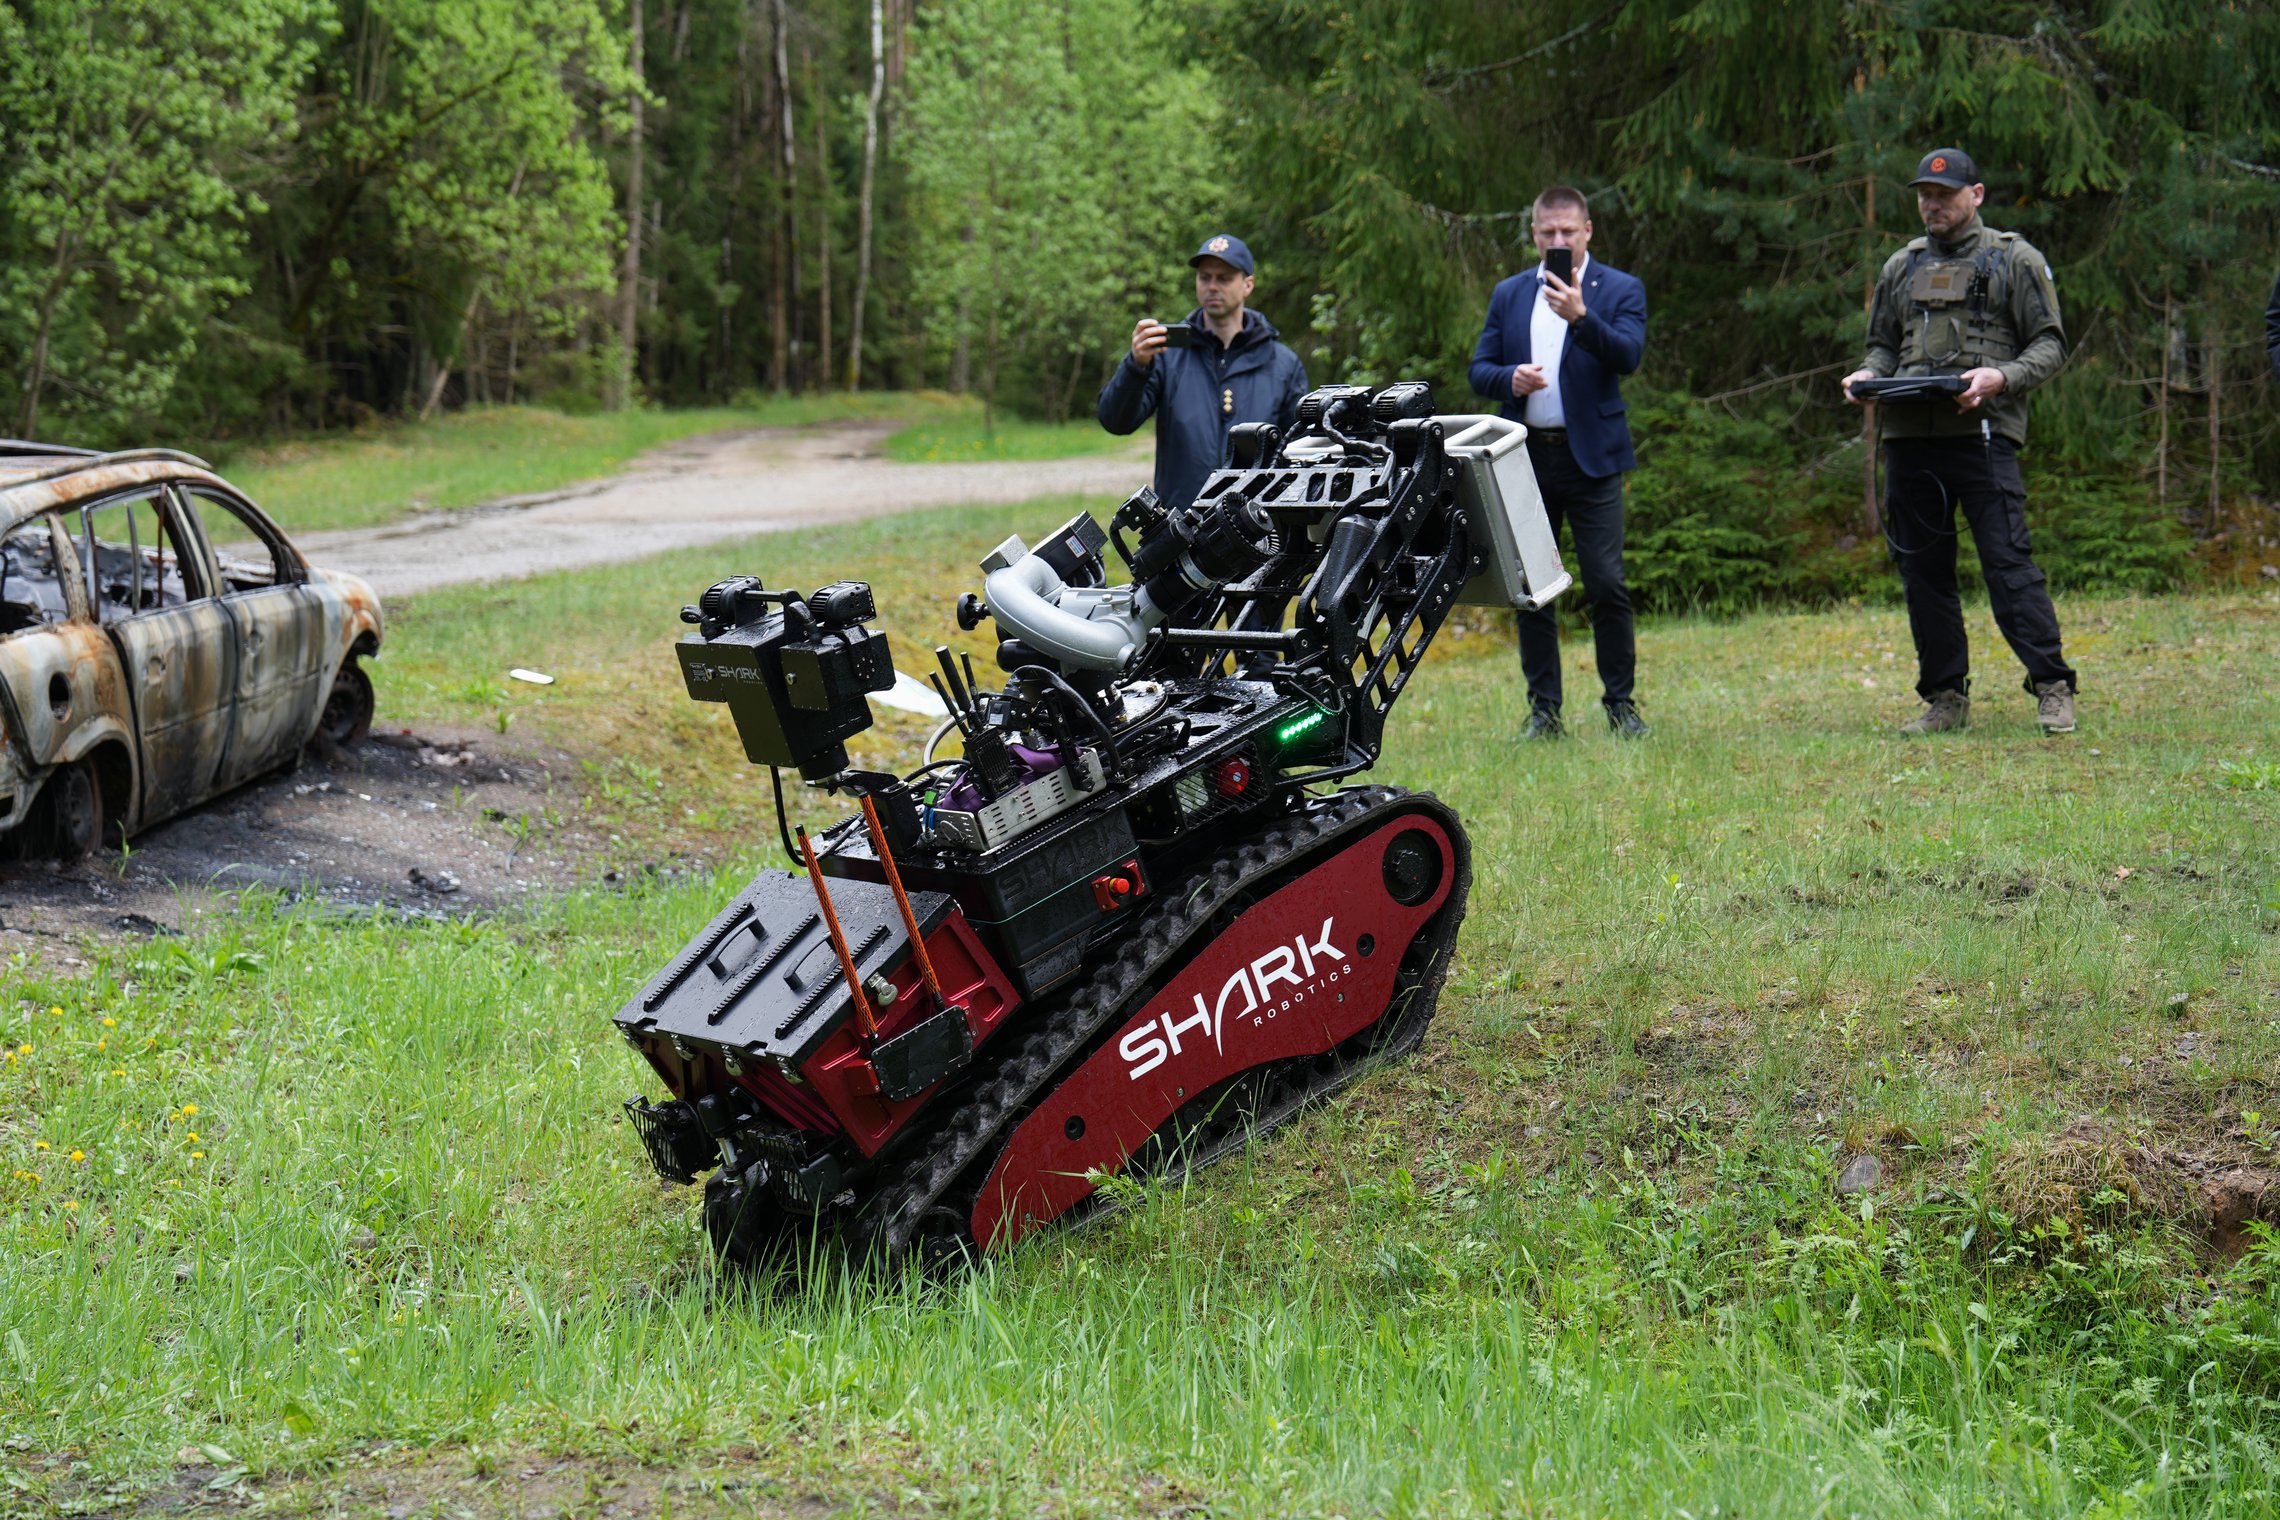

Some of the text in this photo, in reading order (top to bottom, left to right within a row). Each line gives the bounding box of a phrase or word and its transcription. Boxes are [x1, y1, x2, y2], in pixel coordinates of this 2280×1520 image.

[717, 665, 761, 683] SHARK
[1119, 916, 1346, 1081] SHARK
[1253, 964, 1352, 1028] ROBOTICS
